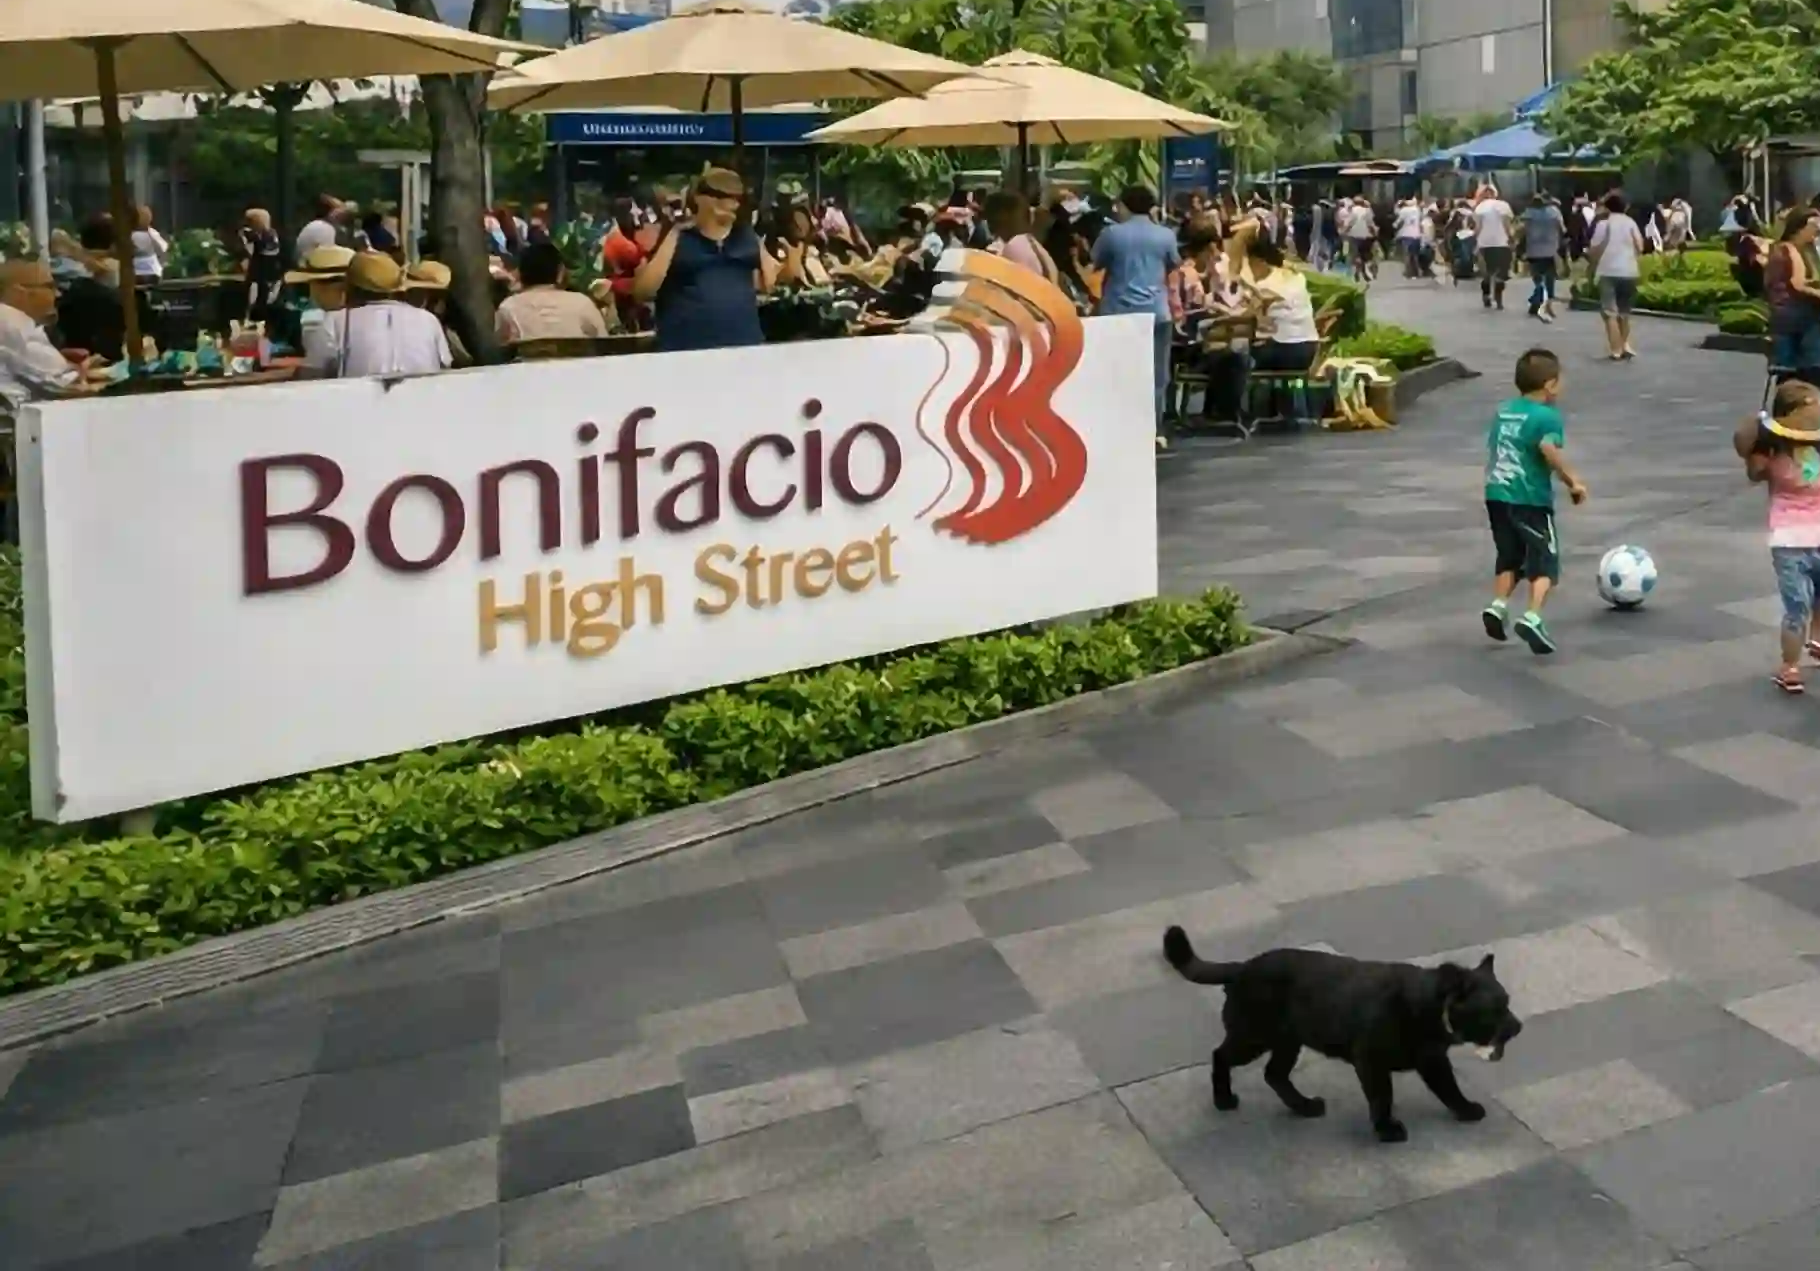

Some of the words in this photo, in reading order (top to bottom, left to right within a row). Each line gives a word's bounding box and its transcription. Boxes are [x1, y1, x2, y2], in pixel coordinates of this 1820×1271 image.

[239, 398, 903, 597] Bonifacio
[479, 558, 664, 659] High
[695, 526, 899, 615] Street
